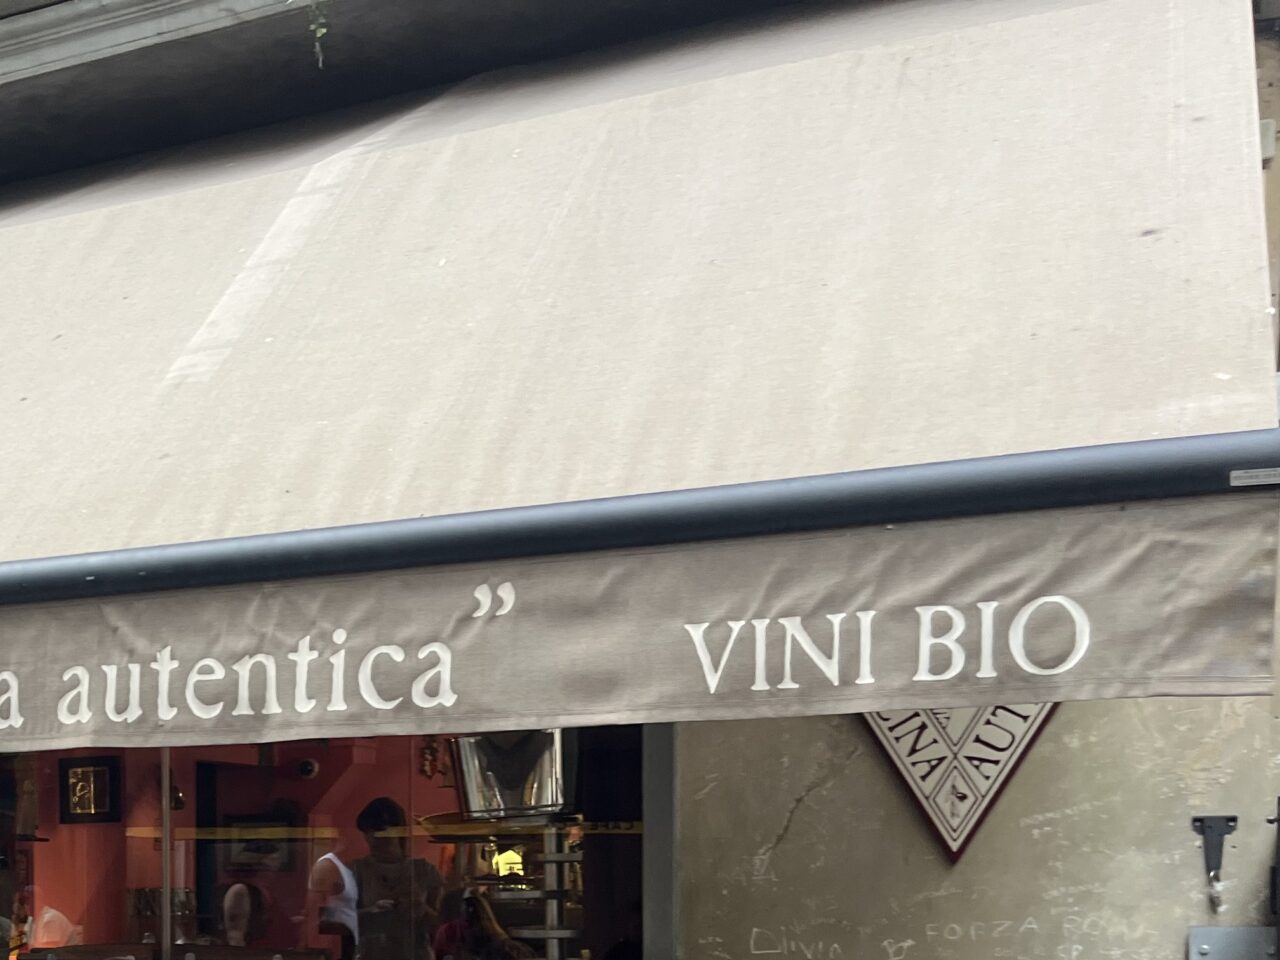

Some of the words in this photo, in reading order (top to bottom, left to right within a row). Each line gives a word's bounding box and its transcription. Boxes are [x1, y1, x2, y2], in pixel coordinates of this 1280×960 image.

[683, 609, 878, 695] VINI
[912, 594, 1091, 681] BIO
[875, 709, 950, 783] INA
[962, 702, 1040, 782] AUT
